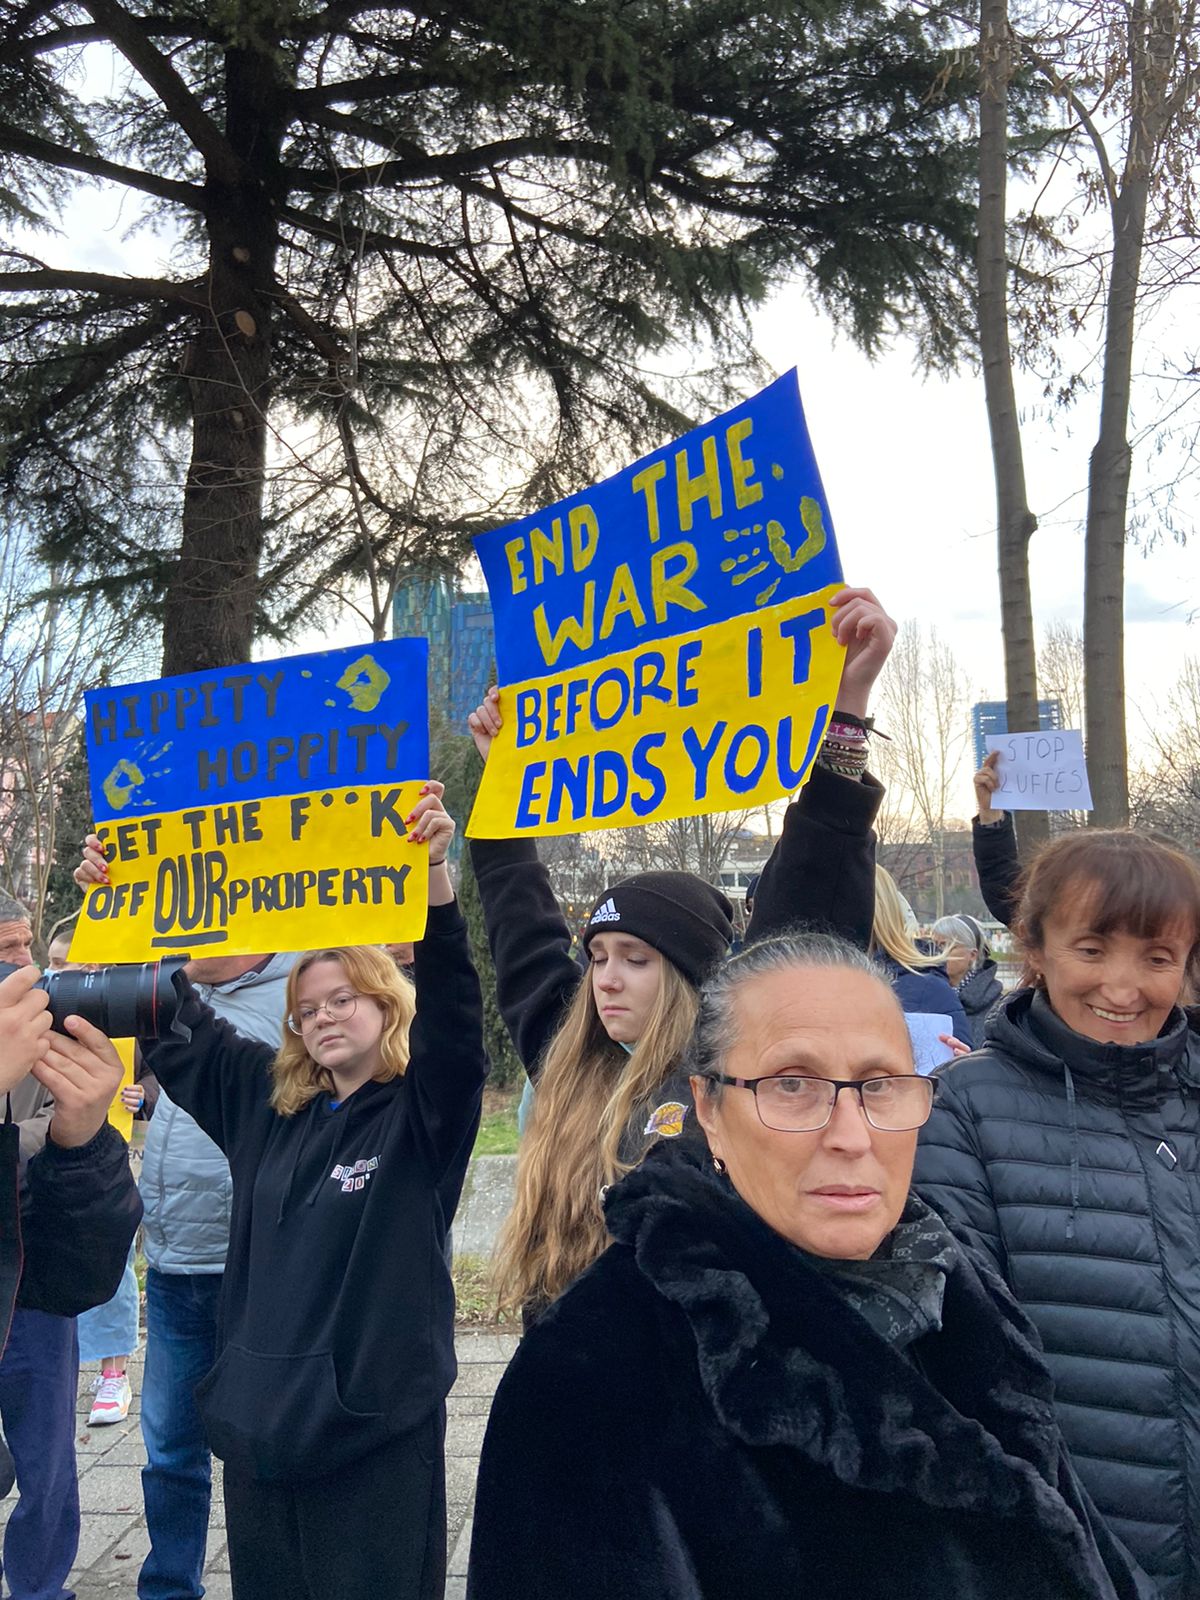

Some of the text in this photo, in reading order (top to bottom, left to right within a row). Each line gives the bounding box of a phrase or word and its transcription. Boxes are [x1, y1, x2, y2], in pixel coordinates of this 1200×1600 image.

[504, 417, 764, 595] END THE
[533, 541, 707, 667] WAR
[92, 671, 285, 746] HIPPITY
[515, 608, 827, 749] BEFORE IT
[197, 721, 410, 791] HOPPITY
[515, 704, 830, 829] ENDS YOU
[1007, 736, 1065, 762] STOP
[96, 818, 162, 863] GET
[183, 801, 263, 850] THE
[86, 850, 412, 934] OFF OUR PROPERTY
[590, 911, 621, 925] adidas
